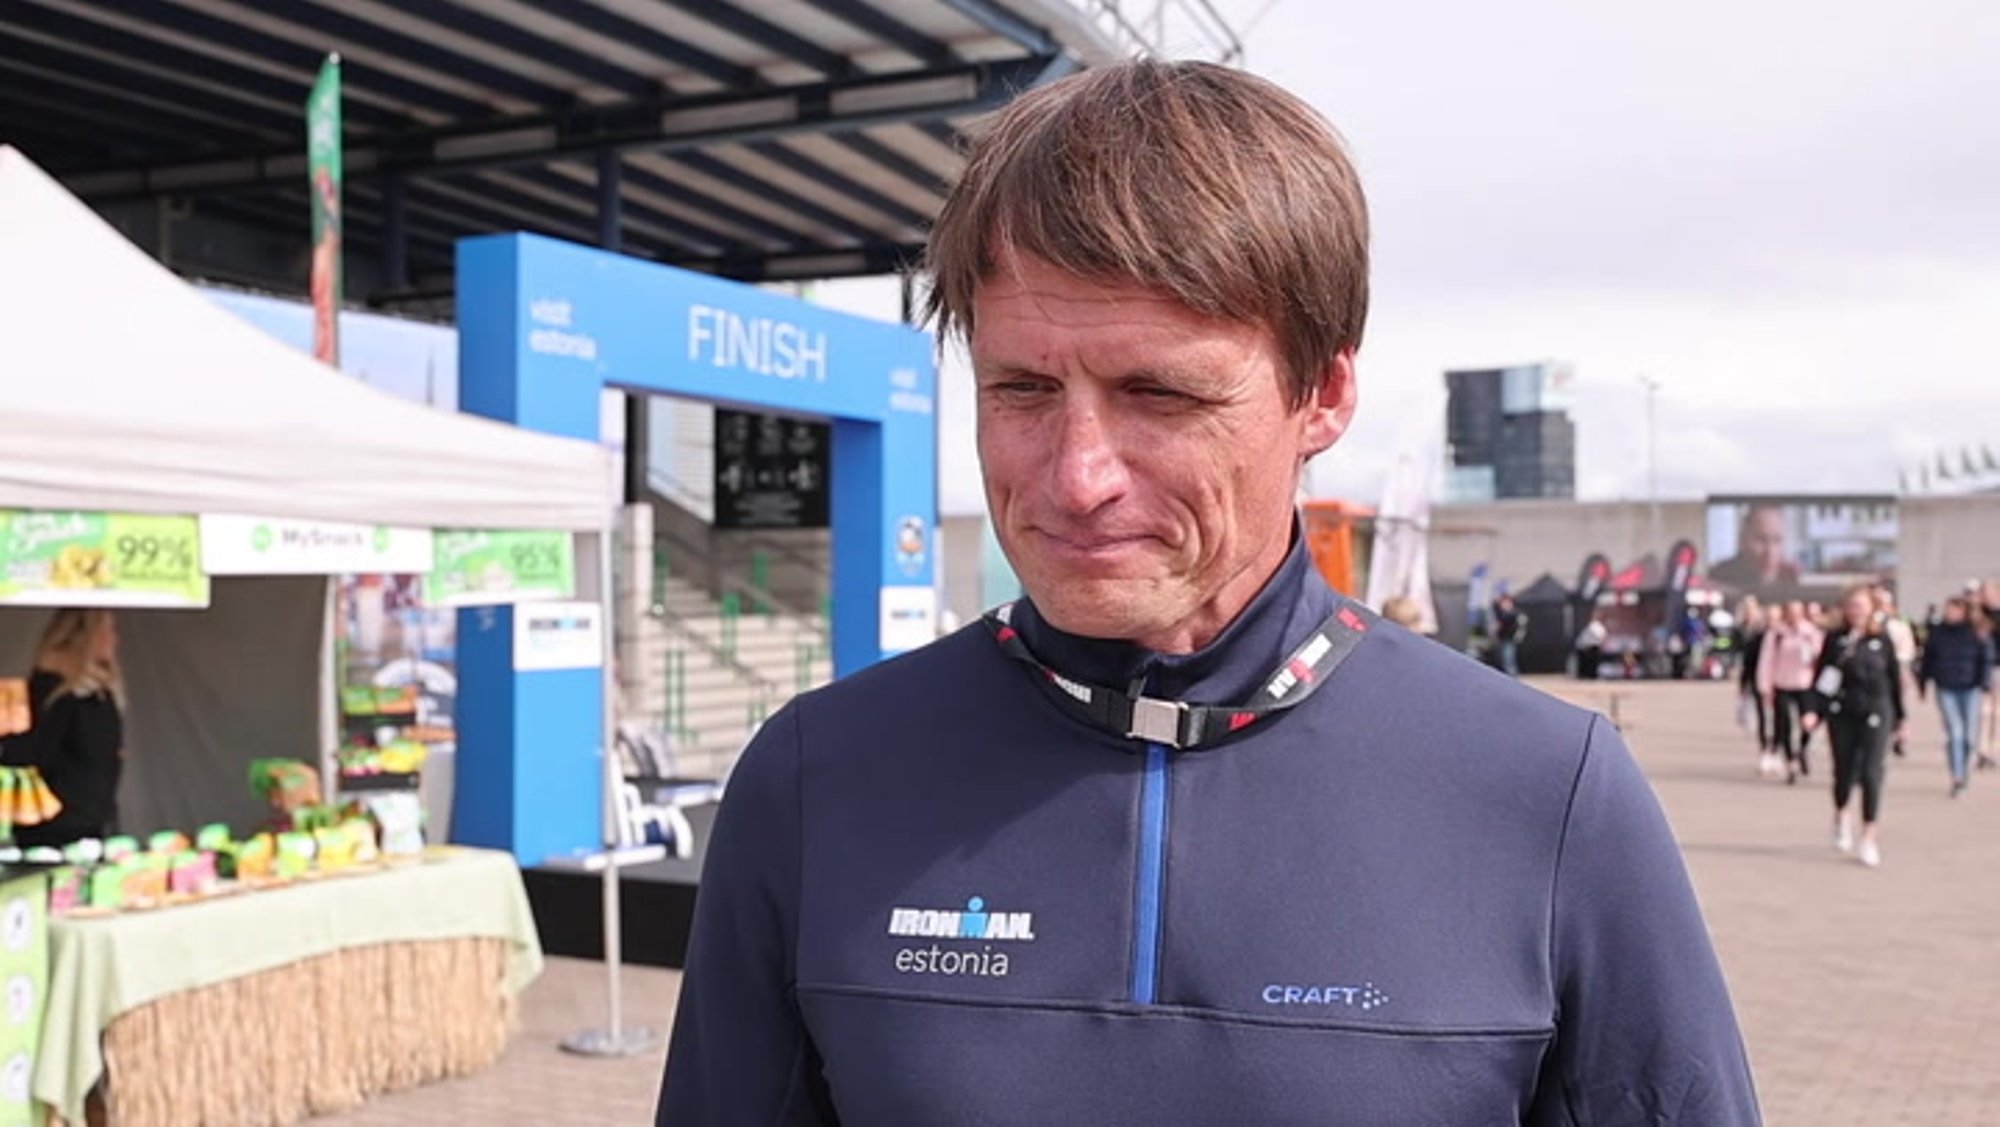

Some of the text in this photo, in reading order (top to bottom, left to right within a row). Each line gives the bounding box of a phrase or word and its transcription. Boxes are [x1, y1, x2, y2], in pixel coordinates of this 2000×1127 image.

[688, 304, 827, 382] FINISH
[117, 535, 192, 568] 99%
[895, 944, 1010, 976] estonia
[1262, 984, 1360, 1005] CRAFT
